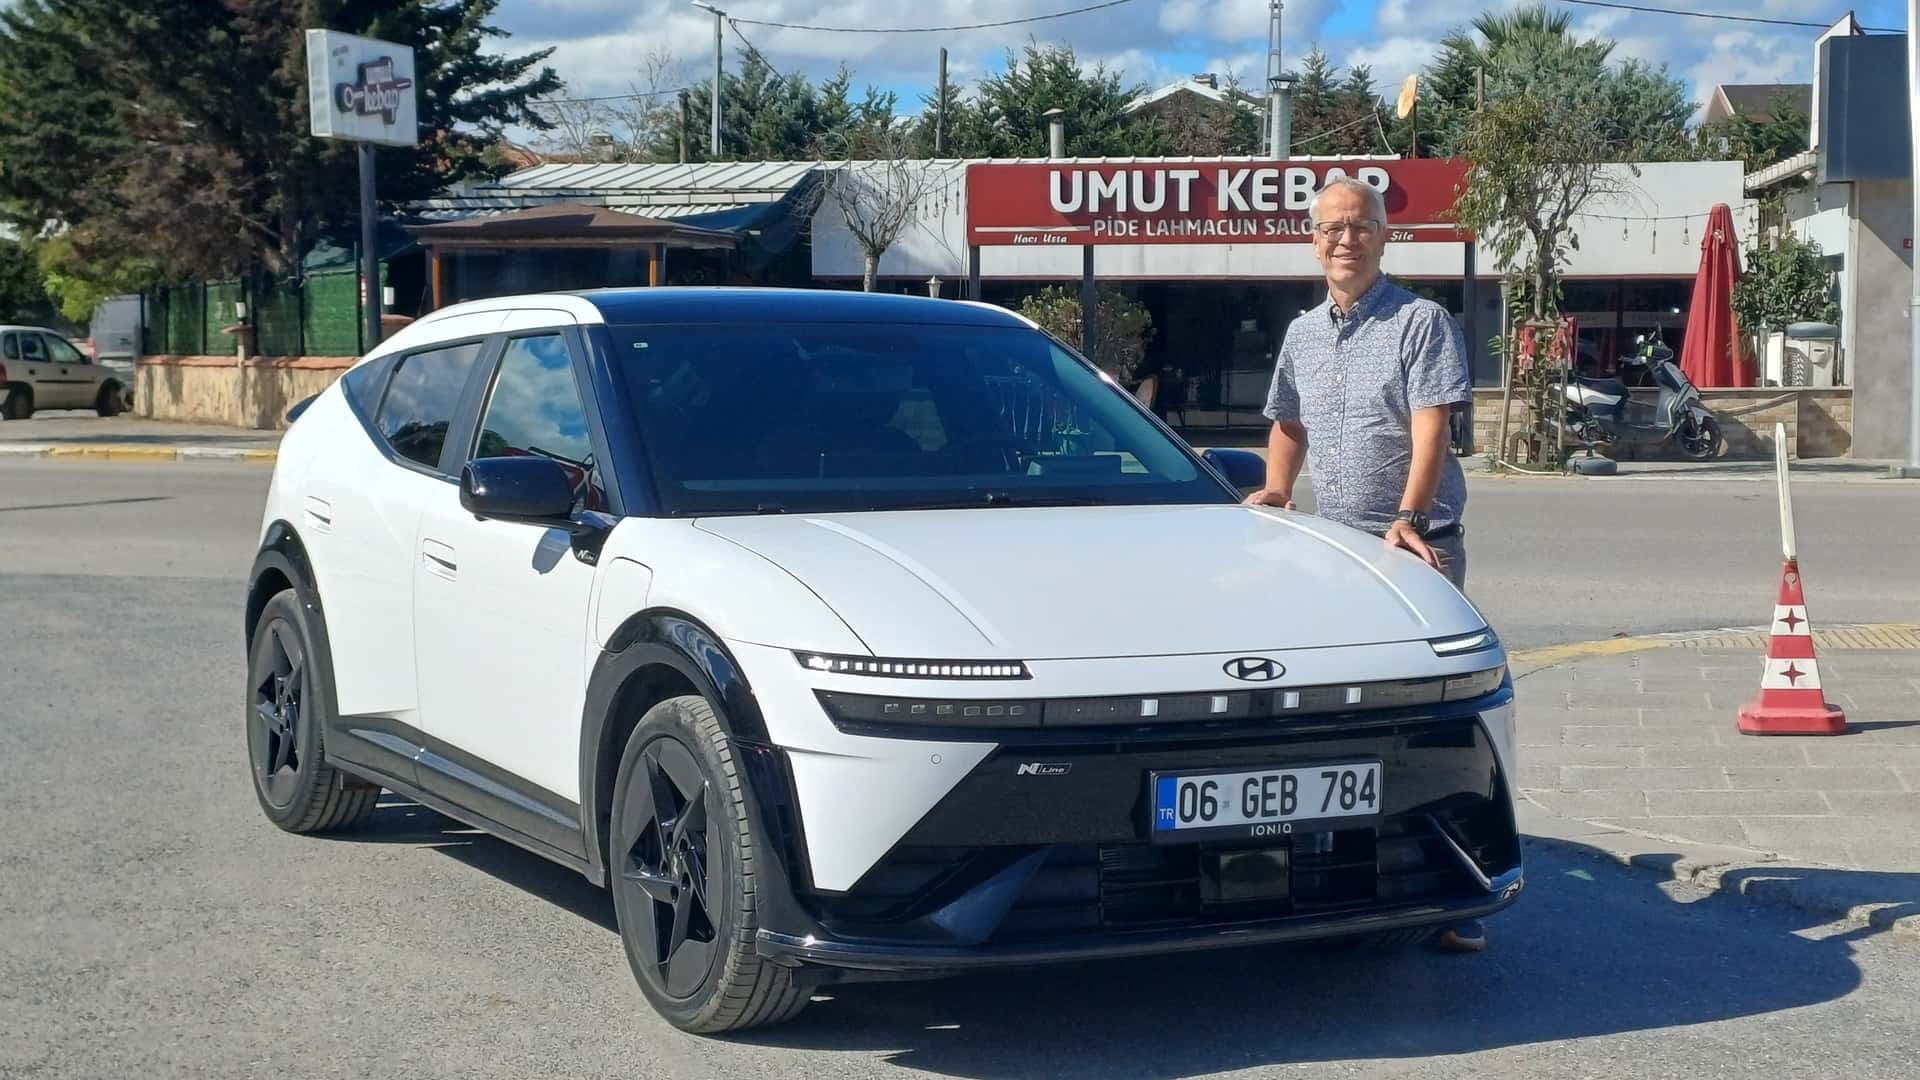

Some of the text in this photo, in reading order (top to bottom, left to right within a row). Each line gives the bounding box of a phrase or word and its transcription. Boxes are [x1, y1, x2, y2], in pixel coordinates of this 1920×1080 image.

[1050, 169, 1200, 213] UMUT
[1094, 216, 1139, 236] PİDE
[1145, 219, 1257, 236] LAHMACUN
[1179, 768, 1377, 823] 06 GEB 784
[1159, 808, 1175, 820] TR
[1250, 823, 1293, 836] IONIQ
